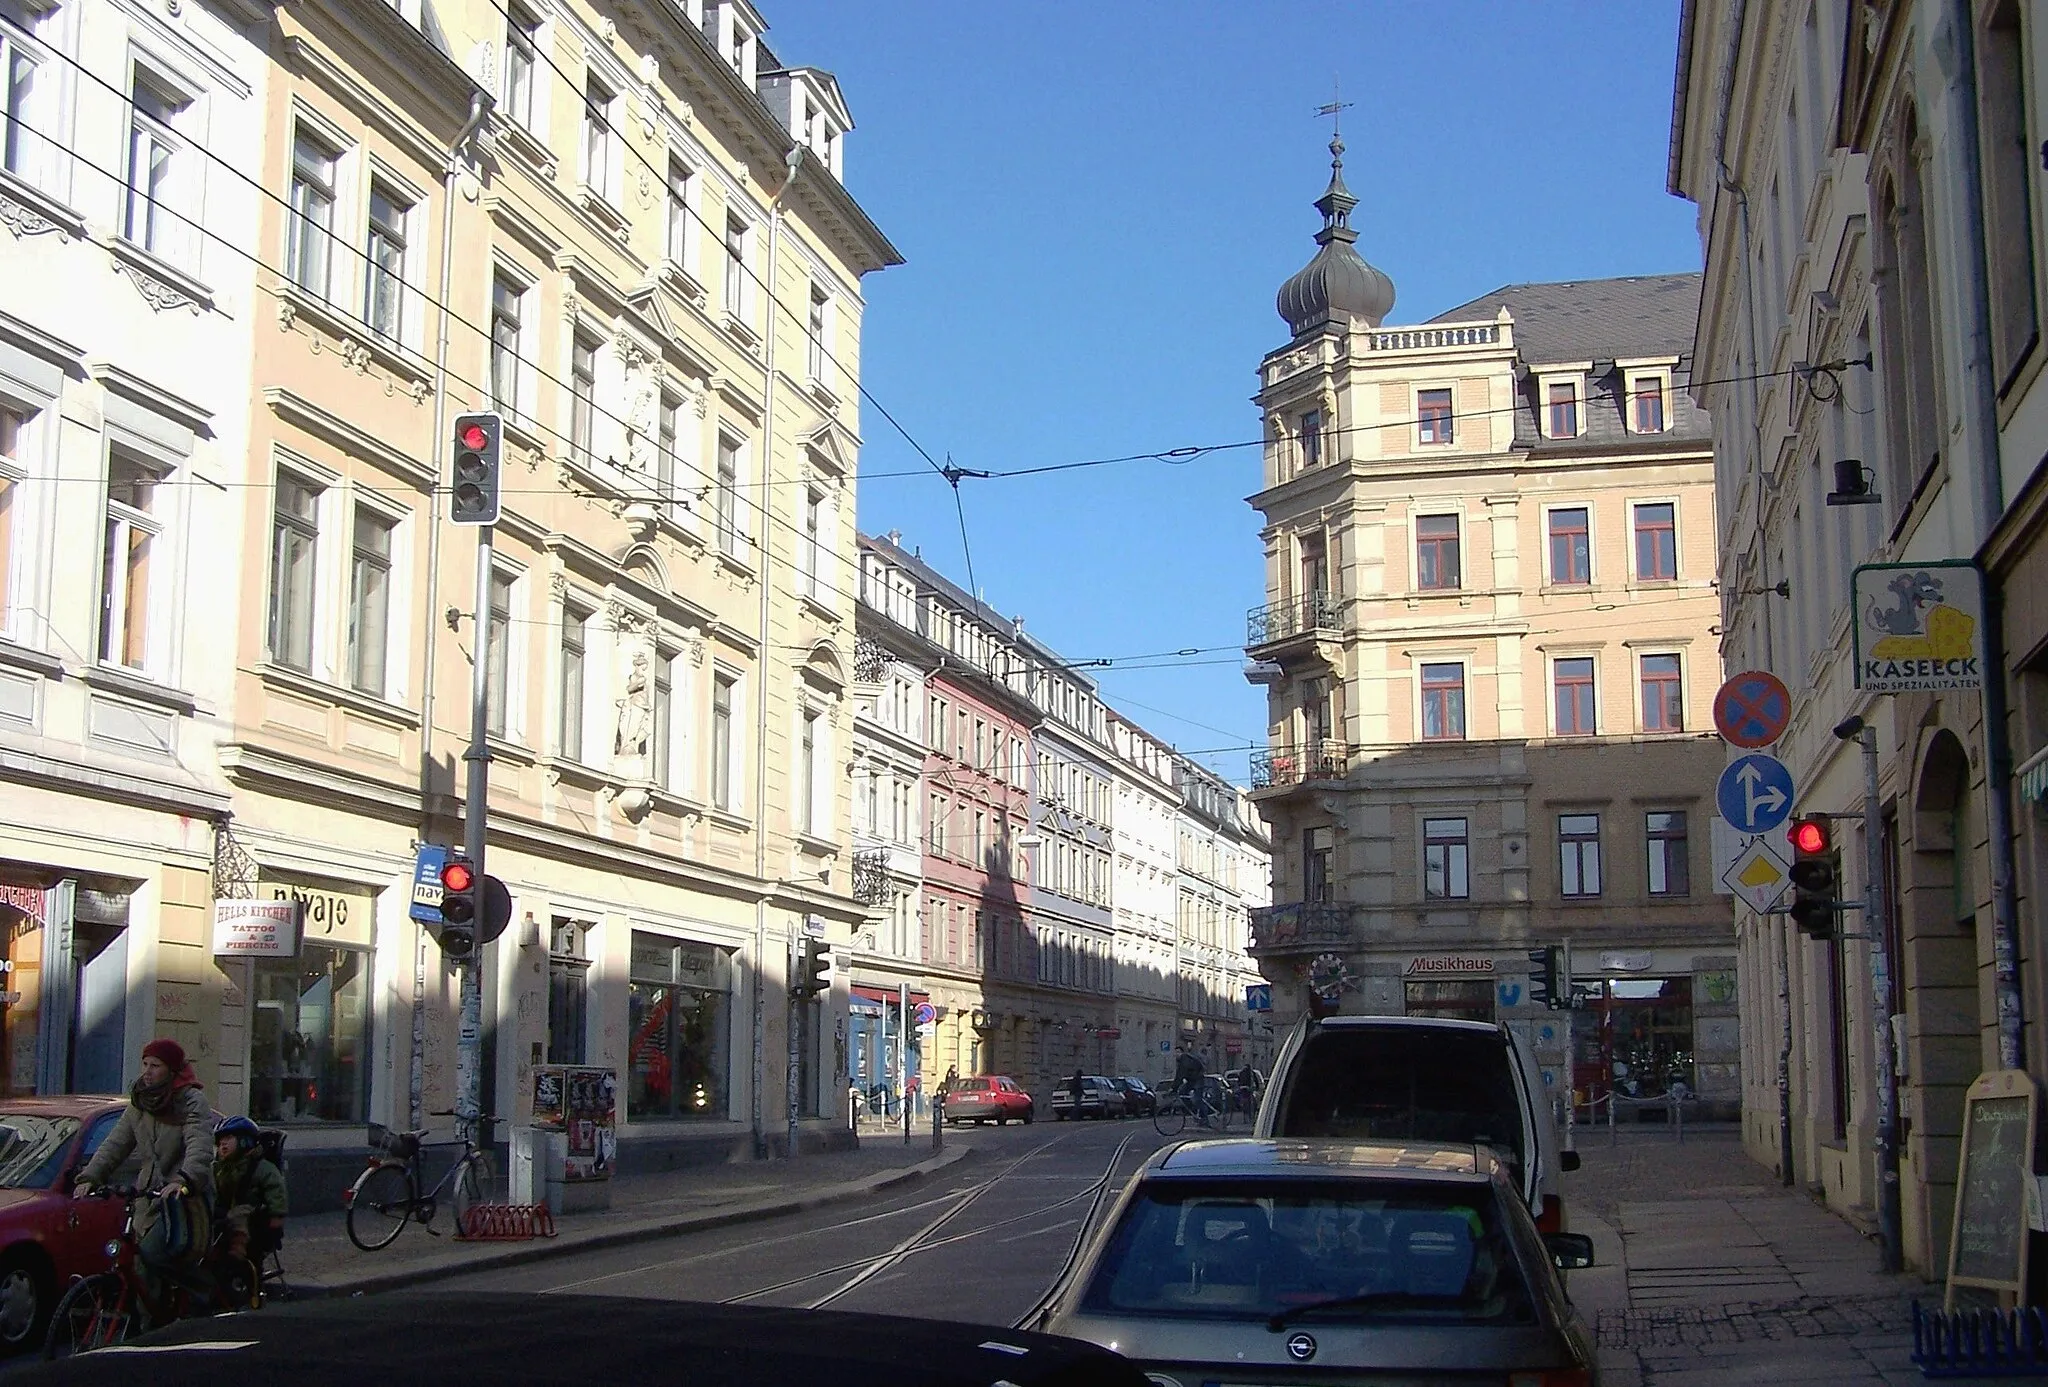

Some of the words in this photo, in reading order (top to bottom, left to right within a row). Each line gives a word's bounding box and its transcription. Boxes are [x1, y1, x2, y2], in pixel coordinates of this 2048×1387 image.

[1865, 657, 1978, 678] KÄSEECK
[1865, 682, 1888, 691] UND
[217, 906, 248, 924] HELLS
[250, 906, 293, 925] KITCHEN
[225, 942, 279, 950] PIERCING
[1407, 957, 1493, 975] Musikhaus
